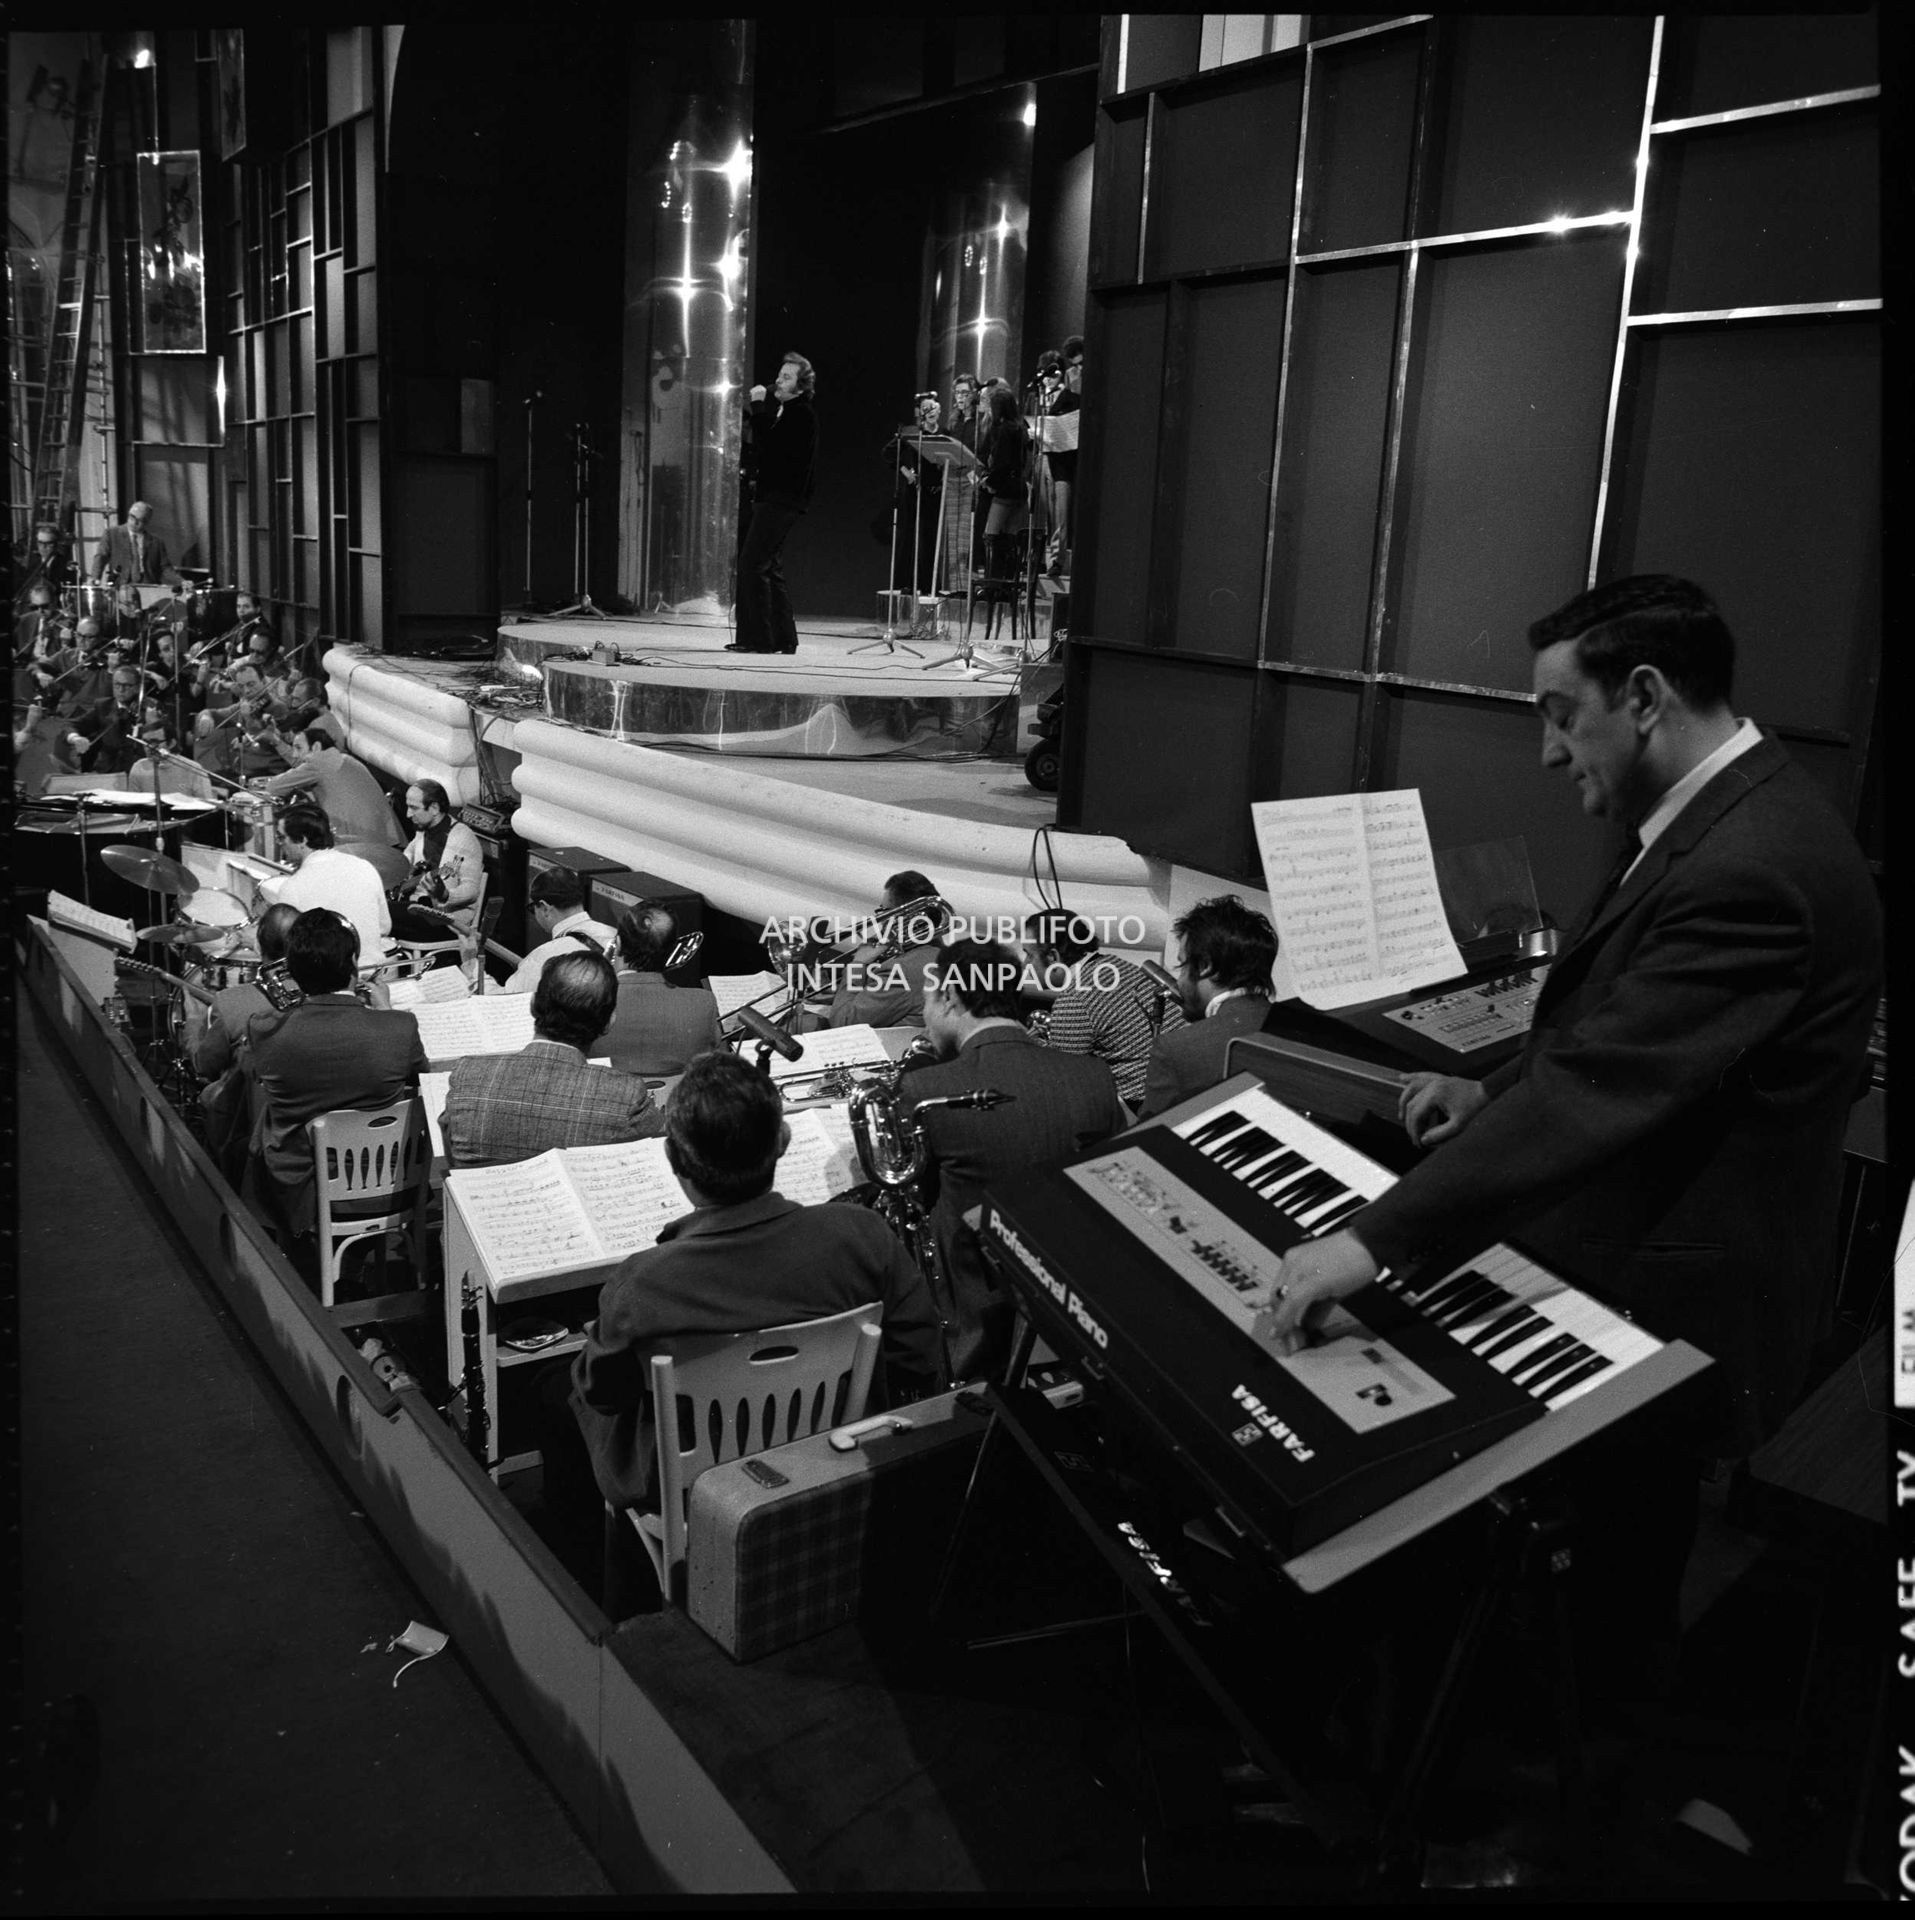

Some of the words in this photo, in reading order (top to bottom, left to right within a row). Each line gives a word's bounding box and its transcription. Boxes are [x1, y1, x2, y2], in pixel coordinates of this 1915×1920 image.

[989, 1208, 1067, 1305] Professional
[1067, 1290, 1109, 1349] Piano
[1231, 1383, 1316, 1463] FARFISA
